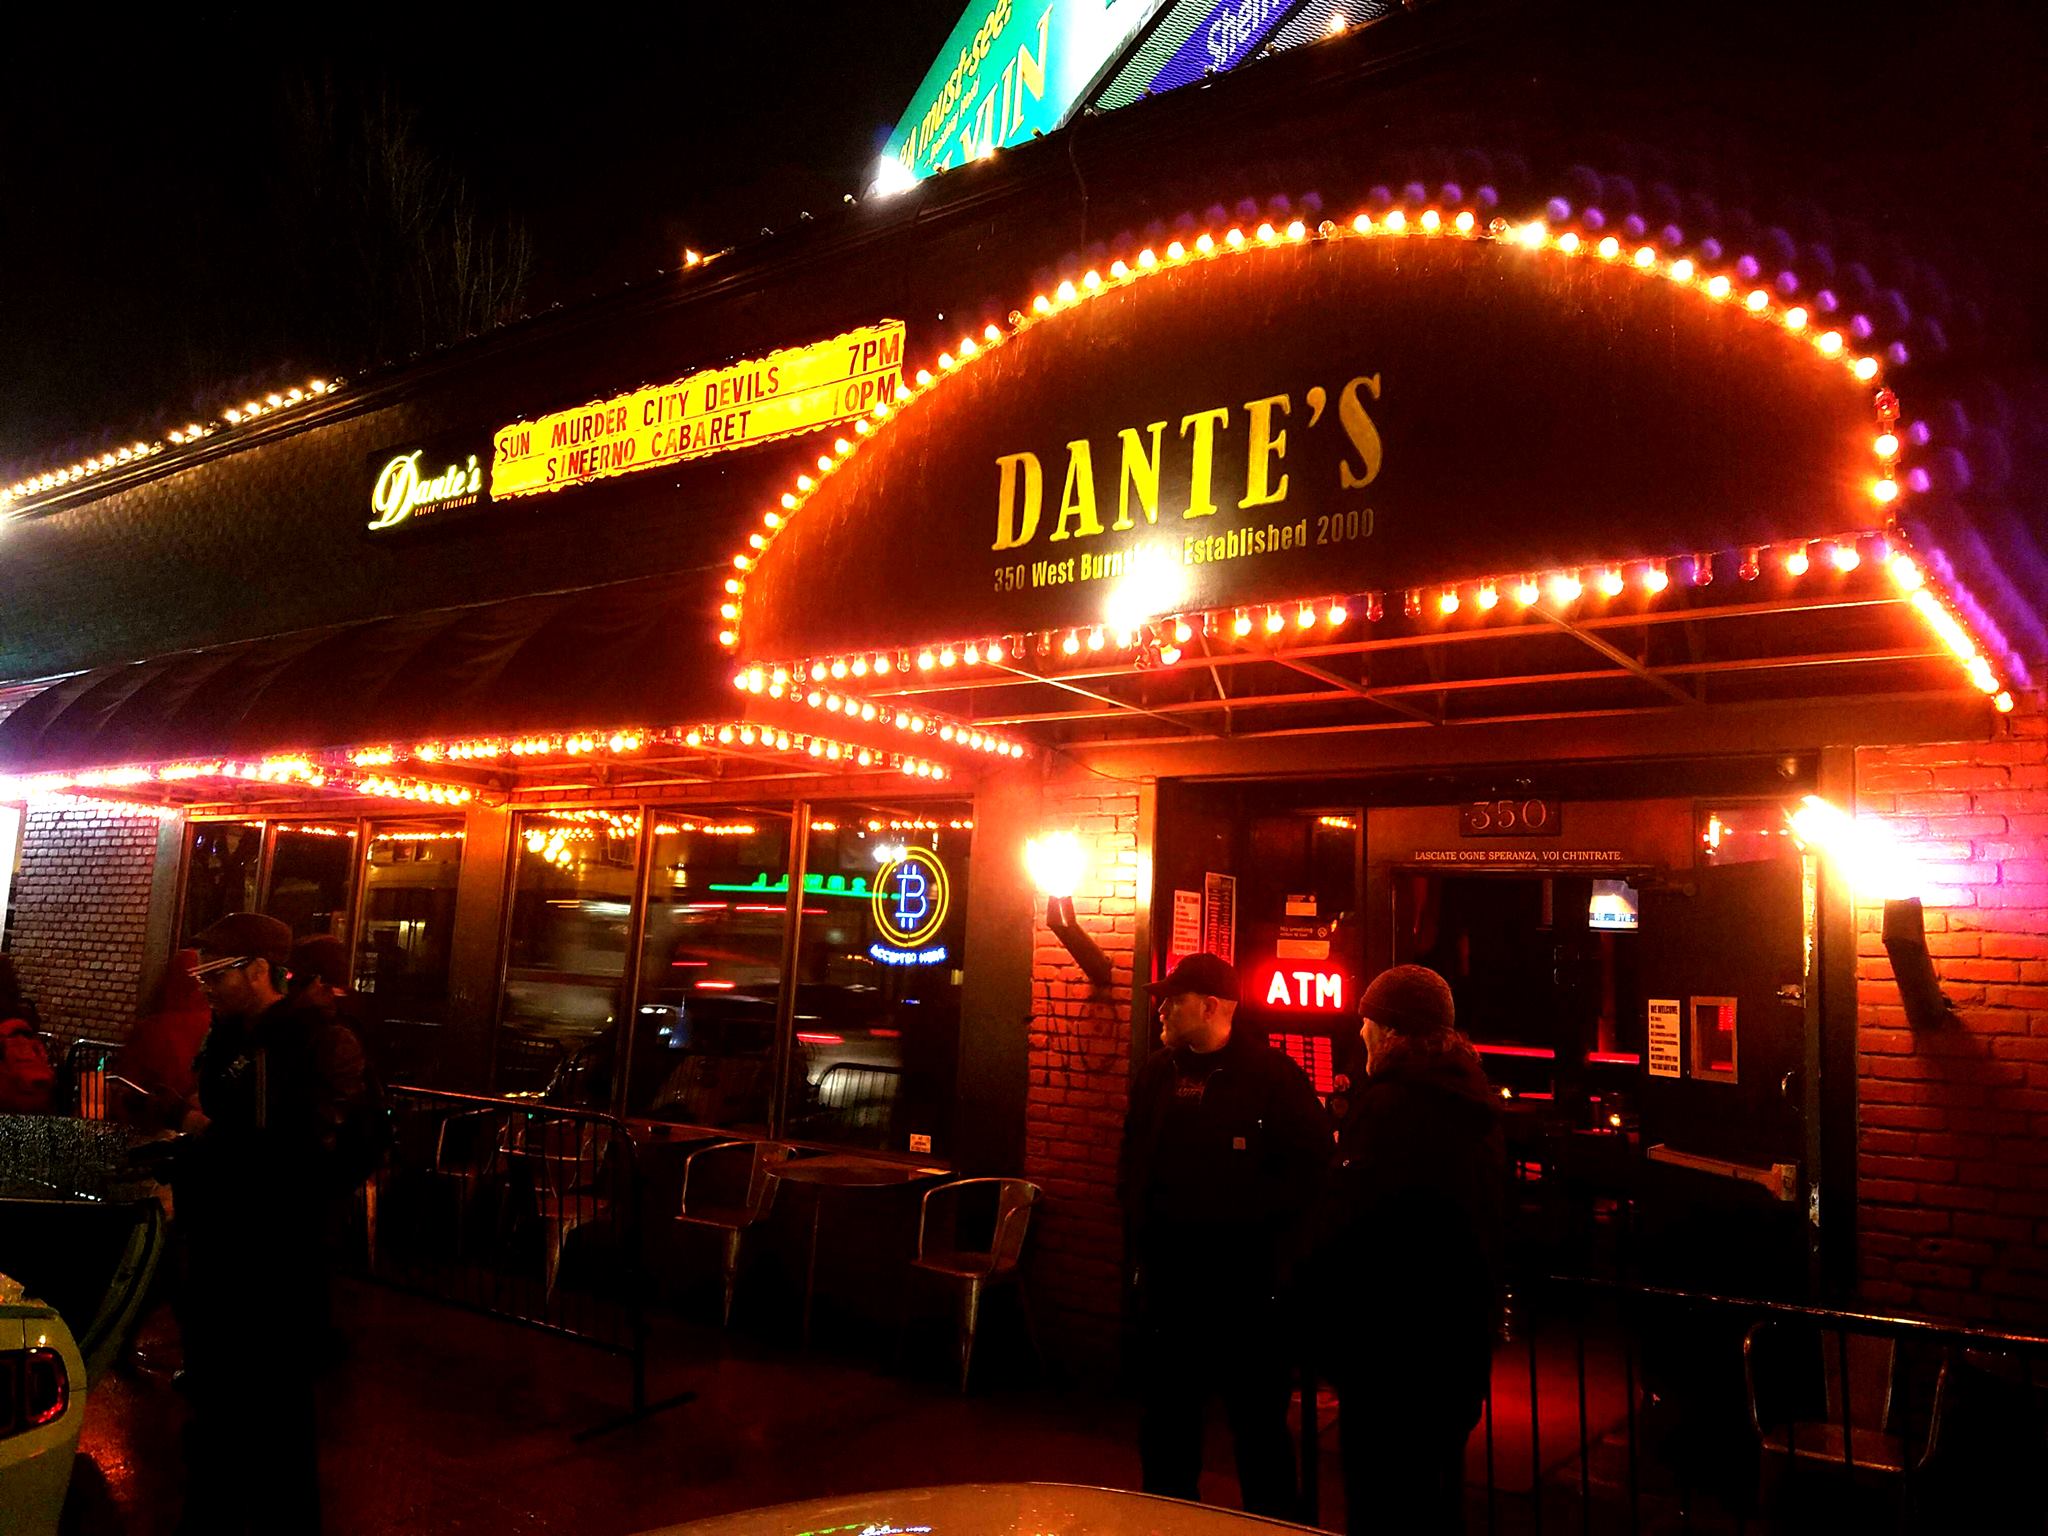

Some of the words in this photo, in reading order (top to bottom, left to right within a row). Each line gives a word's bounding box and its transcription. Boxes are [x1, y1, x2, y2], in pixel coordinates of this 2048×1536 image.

[500, 431, 531, 463] SUN
[551, 406, 628, 449] MURDER
[643, 390, 690, 427] CITY
[705, 367, 779, 412] DEVILS
[849, 333, 900, 375] 7PM
[651, 410, 751, 457] CABARET
[833, 373, 896, 416] 10PM
[368, 449, 482, 531] Dante's
[992, 372, 1383, 552] DANTE'S
[994, 563, 1026, 593] 350
[1032, 557, 1075, 588] West
[1183, 518, 1307, 567] Established
[1317, 508, 1375, 546] 2000
[1415, 851, 1457, 861] LASCIATE
[1459, 851, 1486, 861] OGNE
[1542, 851, 1560, 861] VOI
[1471, 800, 1547, 829] 350
[1266, 971, 1342, 1009] ATM
